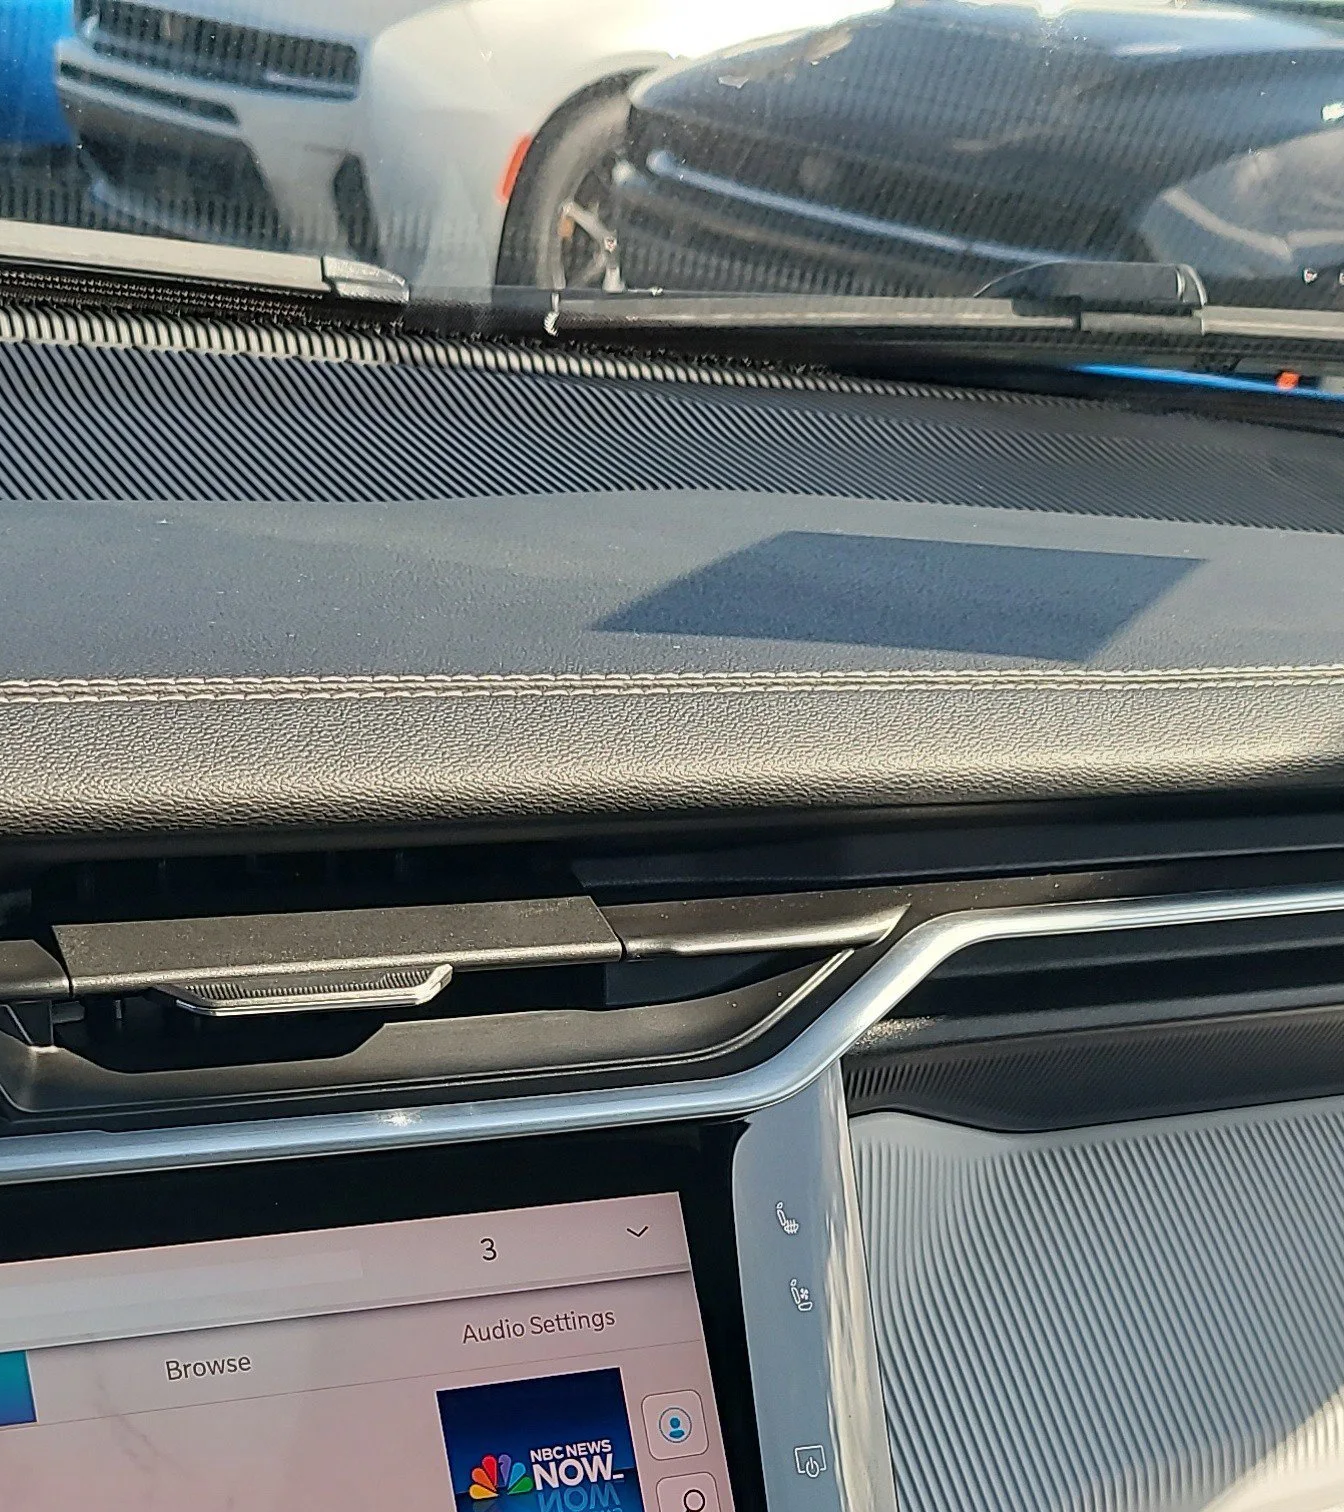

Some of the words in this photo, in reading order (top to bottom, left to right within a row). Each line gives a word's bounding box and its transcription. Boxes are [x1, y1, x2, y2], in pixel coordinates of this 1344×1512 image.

[480, 1238, 498, 1261] 3
[462, 1319, 525, 1345] Audio
[530, 1308, 617, 1336] Settings
[165, 1353, 252, 1381] Browse
[530, 1446, 565, 1463] NBC
[567, 1439, 612, 1459] NEWS
